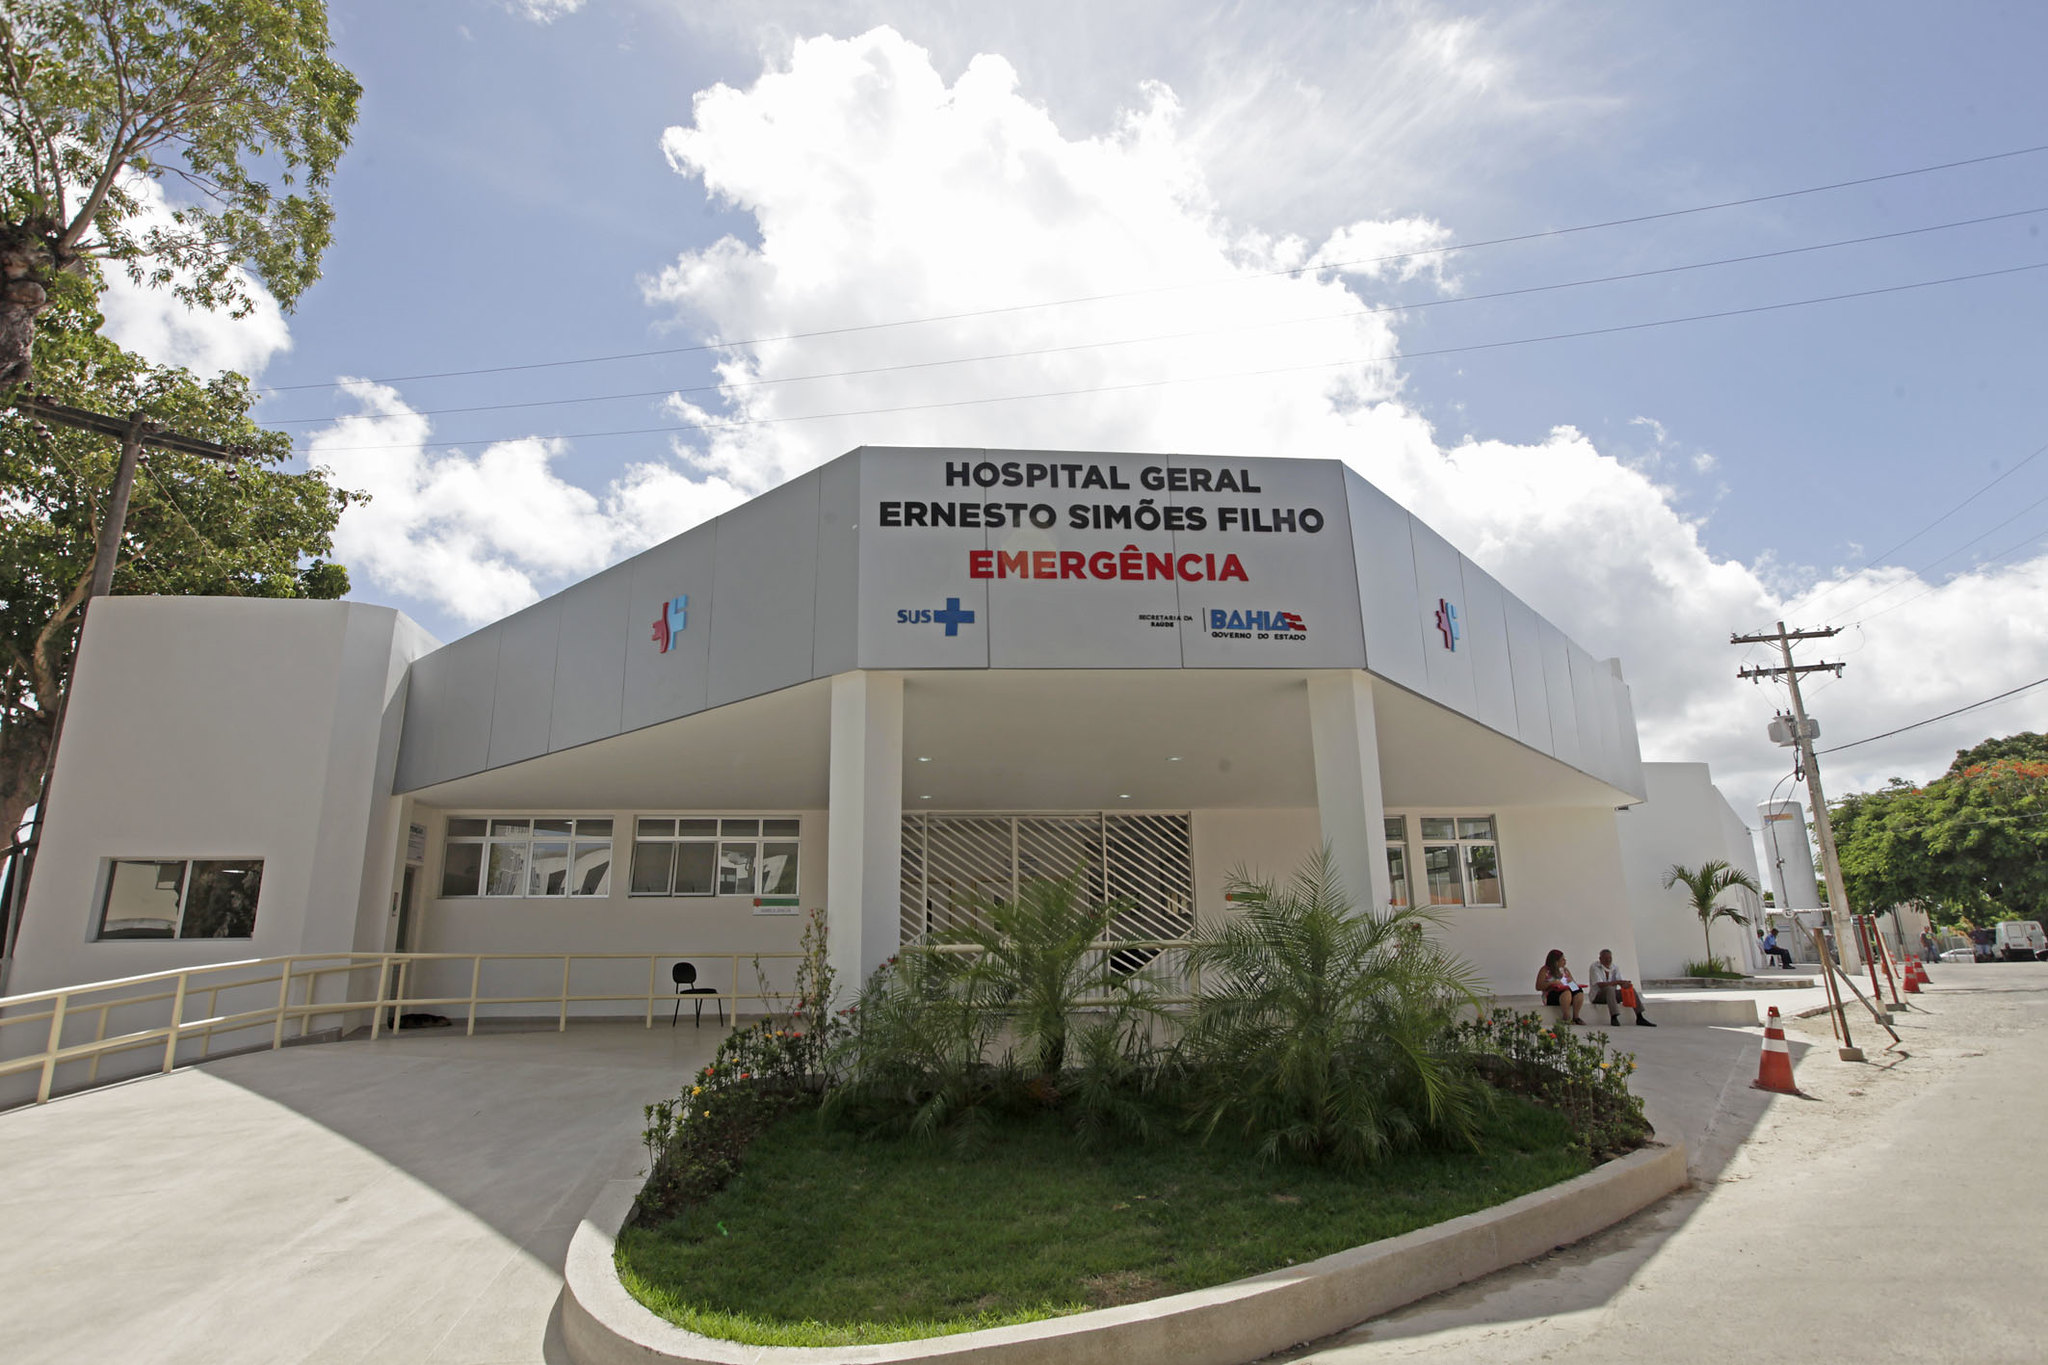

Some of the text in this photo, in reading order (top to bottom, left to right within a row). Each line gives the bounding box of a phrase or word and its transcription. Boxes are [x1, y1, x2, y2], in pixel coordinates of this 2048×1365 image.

[945, 461, 1262, 494] HOSPITAL GERAL
[879, 498, 1325, 534] ERNESTO SIMÕES FILHO
[969, 544, 1250, 582] EMERGÊNCIA
[896, 609, 932, 625] SUS
[1138, 614, 1182, 622] SECRETARIA
[1210, 609, 1290, 632] BAHIA
[1210, 631, 1252, 640] GOVERNO
[1273, 633, 1307, 641] ESTADO
